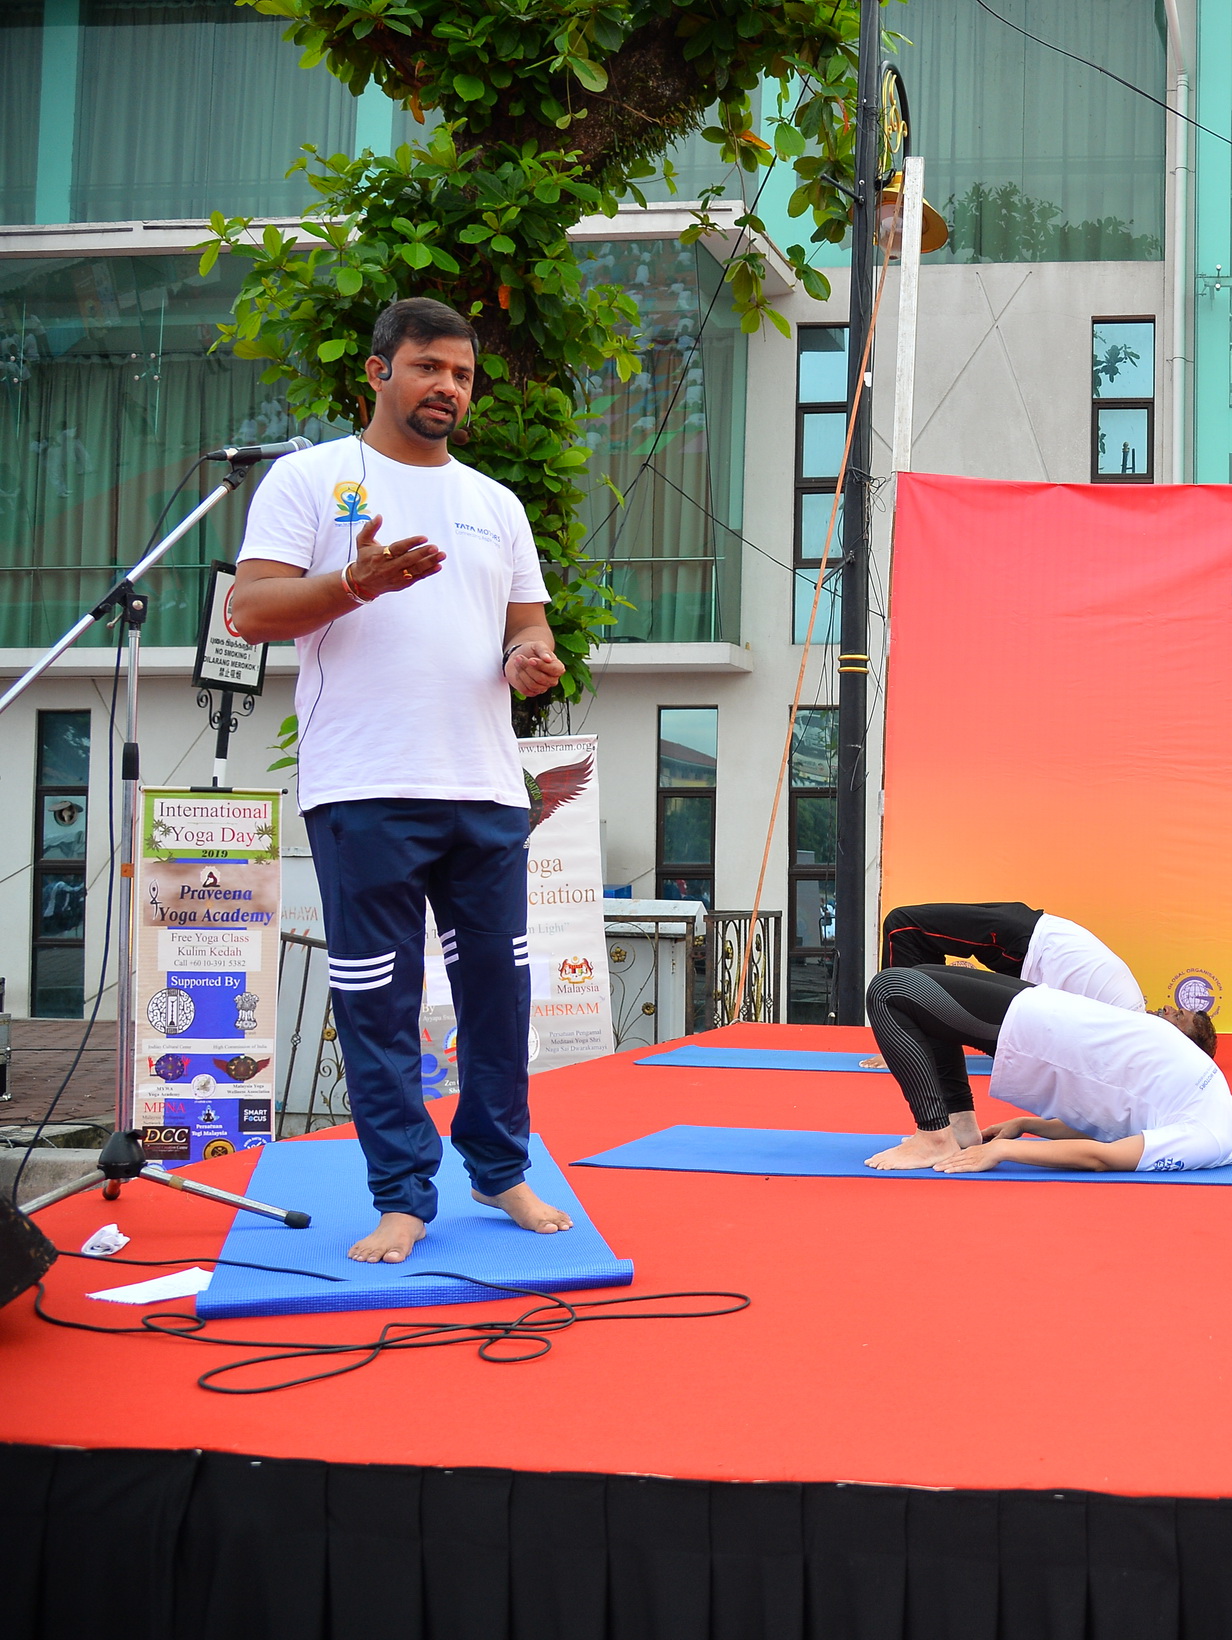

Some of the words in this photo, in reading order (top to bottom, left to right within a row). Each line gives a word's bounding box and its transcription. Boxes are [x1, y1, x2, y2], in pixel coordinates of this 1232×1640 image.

[455, 522, 476, 532] TATA
[215, 647, 224, 655] NO
[224, 649, 248, 660] SMOKING
[203, 655, 230, 667] DILARANG
[230, 660, 256, 671] MEROKOK
[160, 802, 268, 819] International
[171, 826, 214, 846] Yoga
[220, 827, 256, 847] Day
[201, 849, 228, 858] 2019
[527, 858, 563, 879] oga
[180, 885, 253, 900] Praveena
[528, 883, 597, 906] ciation
[160, 907, 197, 925] Yoga
[201, 908, 275, 926] Academy
[281, 906, 318, 921] AHAYA
[171, 933, 193, 942] Free
[195, 933, 219, 945] Yoga
[221, 933, 250, 943] Class
[177, 947, 207, 957] Kulim
[209, 947, 242, 957] Kedah
[171, 976, 221, 989] Supported
[225, 976, 241, 989] By
[1167, 971, 1186, 990] GLOBAL
[557, 983, 600, 995] Malaysia
[575, 1029, 602, 1037] Pengamal
[144, 1102, 186, 1113] MPNA
[243, 1108, 268, 1116] SMART
[144, 1128, 189, 1143] DCC
